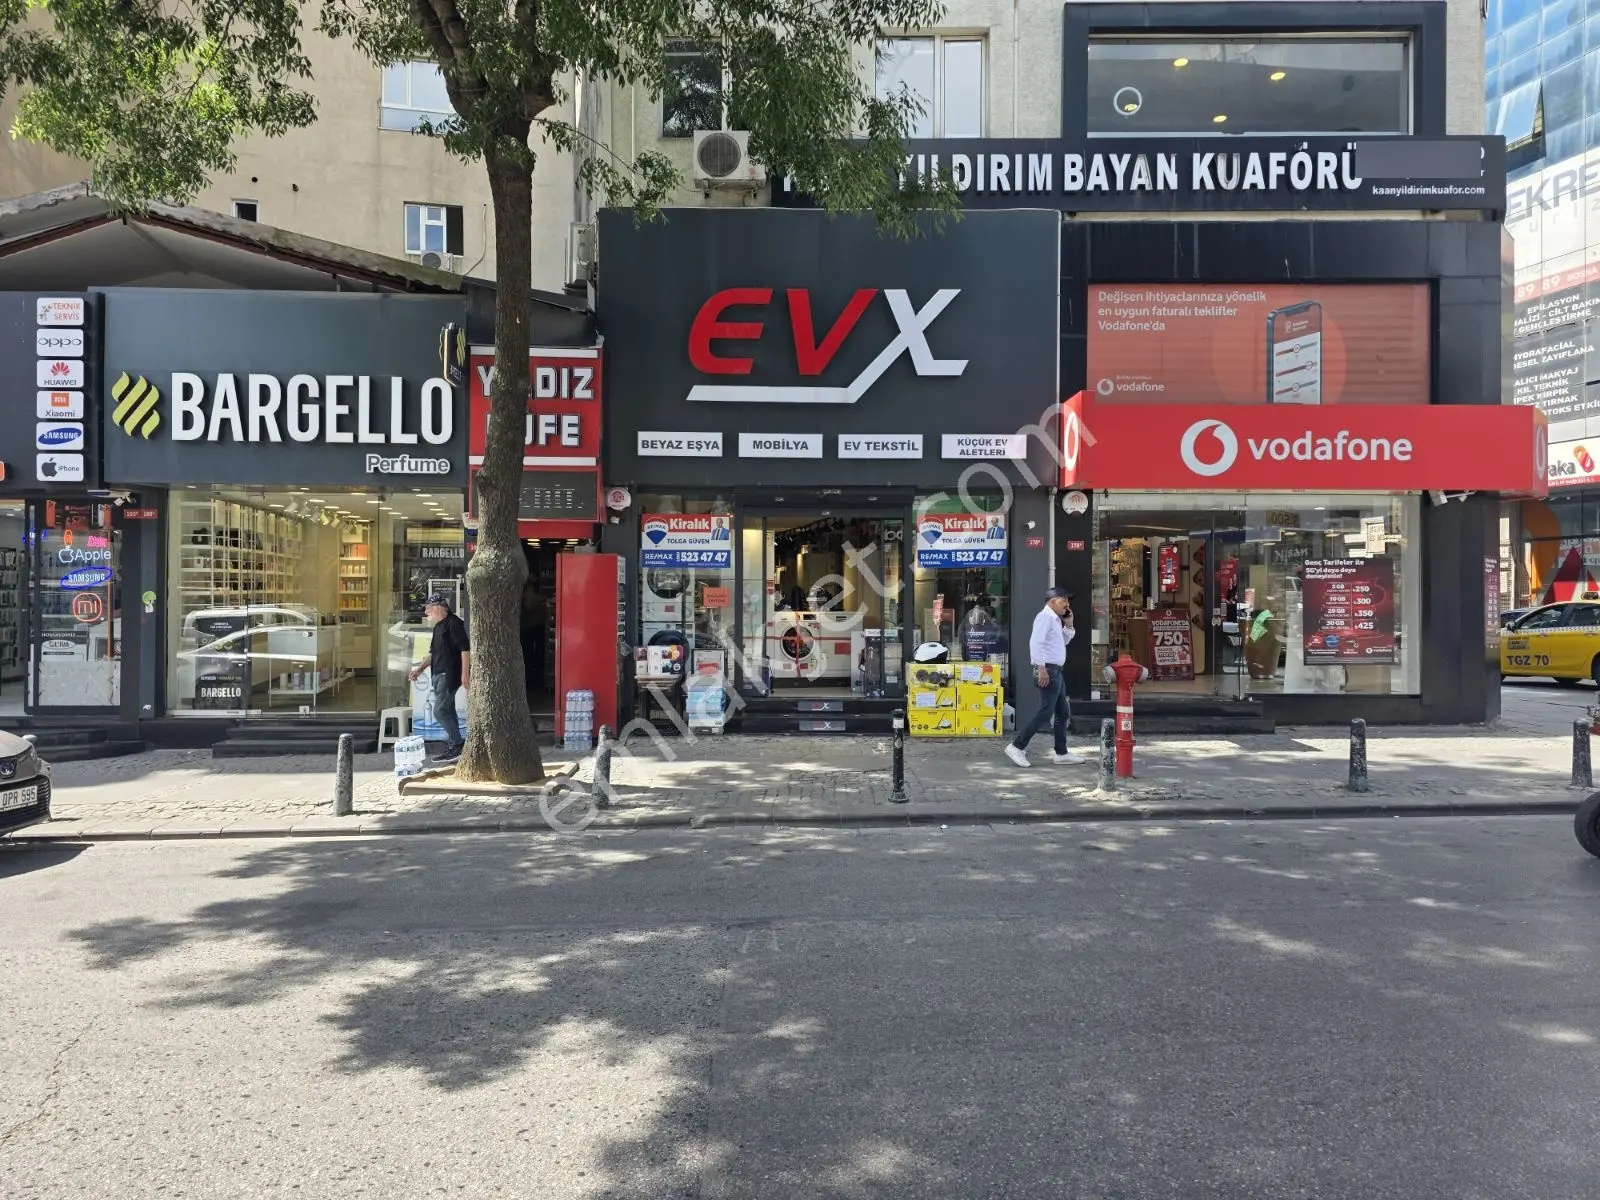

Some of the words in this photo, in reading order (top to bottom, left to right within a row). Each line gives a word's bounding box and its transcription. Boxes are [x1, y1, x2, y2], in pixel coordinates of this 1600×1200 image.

[1064, 152, 1178, 192] BAYAN
[1373, 185, 1485, 197] kaanyildirimkuafor.com
[1098, 291, 1143, 303] Değişen
[1146, 291, 1222, 303] ihtiyaçlarınıza
[1225, 291, 1266, 303] yönelik
[1115, 309, 1149, 318] uygun
[1152, 307, 1191, 316] faturalı
[1195, 307, 1237, 316] teklifler
[1098, 321, 1165, 331] Vodafone'da
[687, 287, 969, 403] EVX
[476, 365, 595, 400] YDIZ
[1116, 381, 1164, 391] vodafone
[171, 372, 453, 444] BARGELLO
[43, 431, 79, 439] SAMSUNG
[641, 439, 683, 449] BEYAZ
[687, 440, 720, 452] EŞYA
[752, 438, 809, 450] MOBİLYA
[844, 441, 861, 450] EV
[864, 439, 919, 451] TEKSTİL
[957, 437, 992, 448] KÜÇÜK
[1247, 431, 1413, 461] vodafone
[366, 453, 450, 473] Perfume
[669, 518, 710, 530] Kiralık
[944, 517, 985, 530] Kiralık
[75, 549, 112, 563] Apple
[422, 547, 464, 558] BARGELLO
[681, 552, 699, 562] 523
[700, 552, 714, 562] 47
[715, 552, 728, 562] 47
[956, 551, 974, 561] 523
[976, 551, 989, 561] 47
[990, 551, 1004, 561] 47
[69, 573, 105, 582] SAMSUNG
[1153, 631, 1183, 646] 750
[1506, 655, 1531, 666] TGZ
[1535, 655, 1550, 666] 70
[201, 687, 241, 698] BARGELLO
[21, 787, 36, 802] 595
